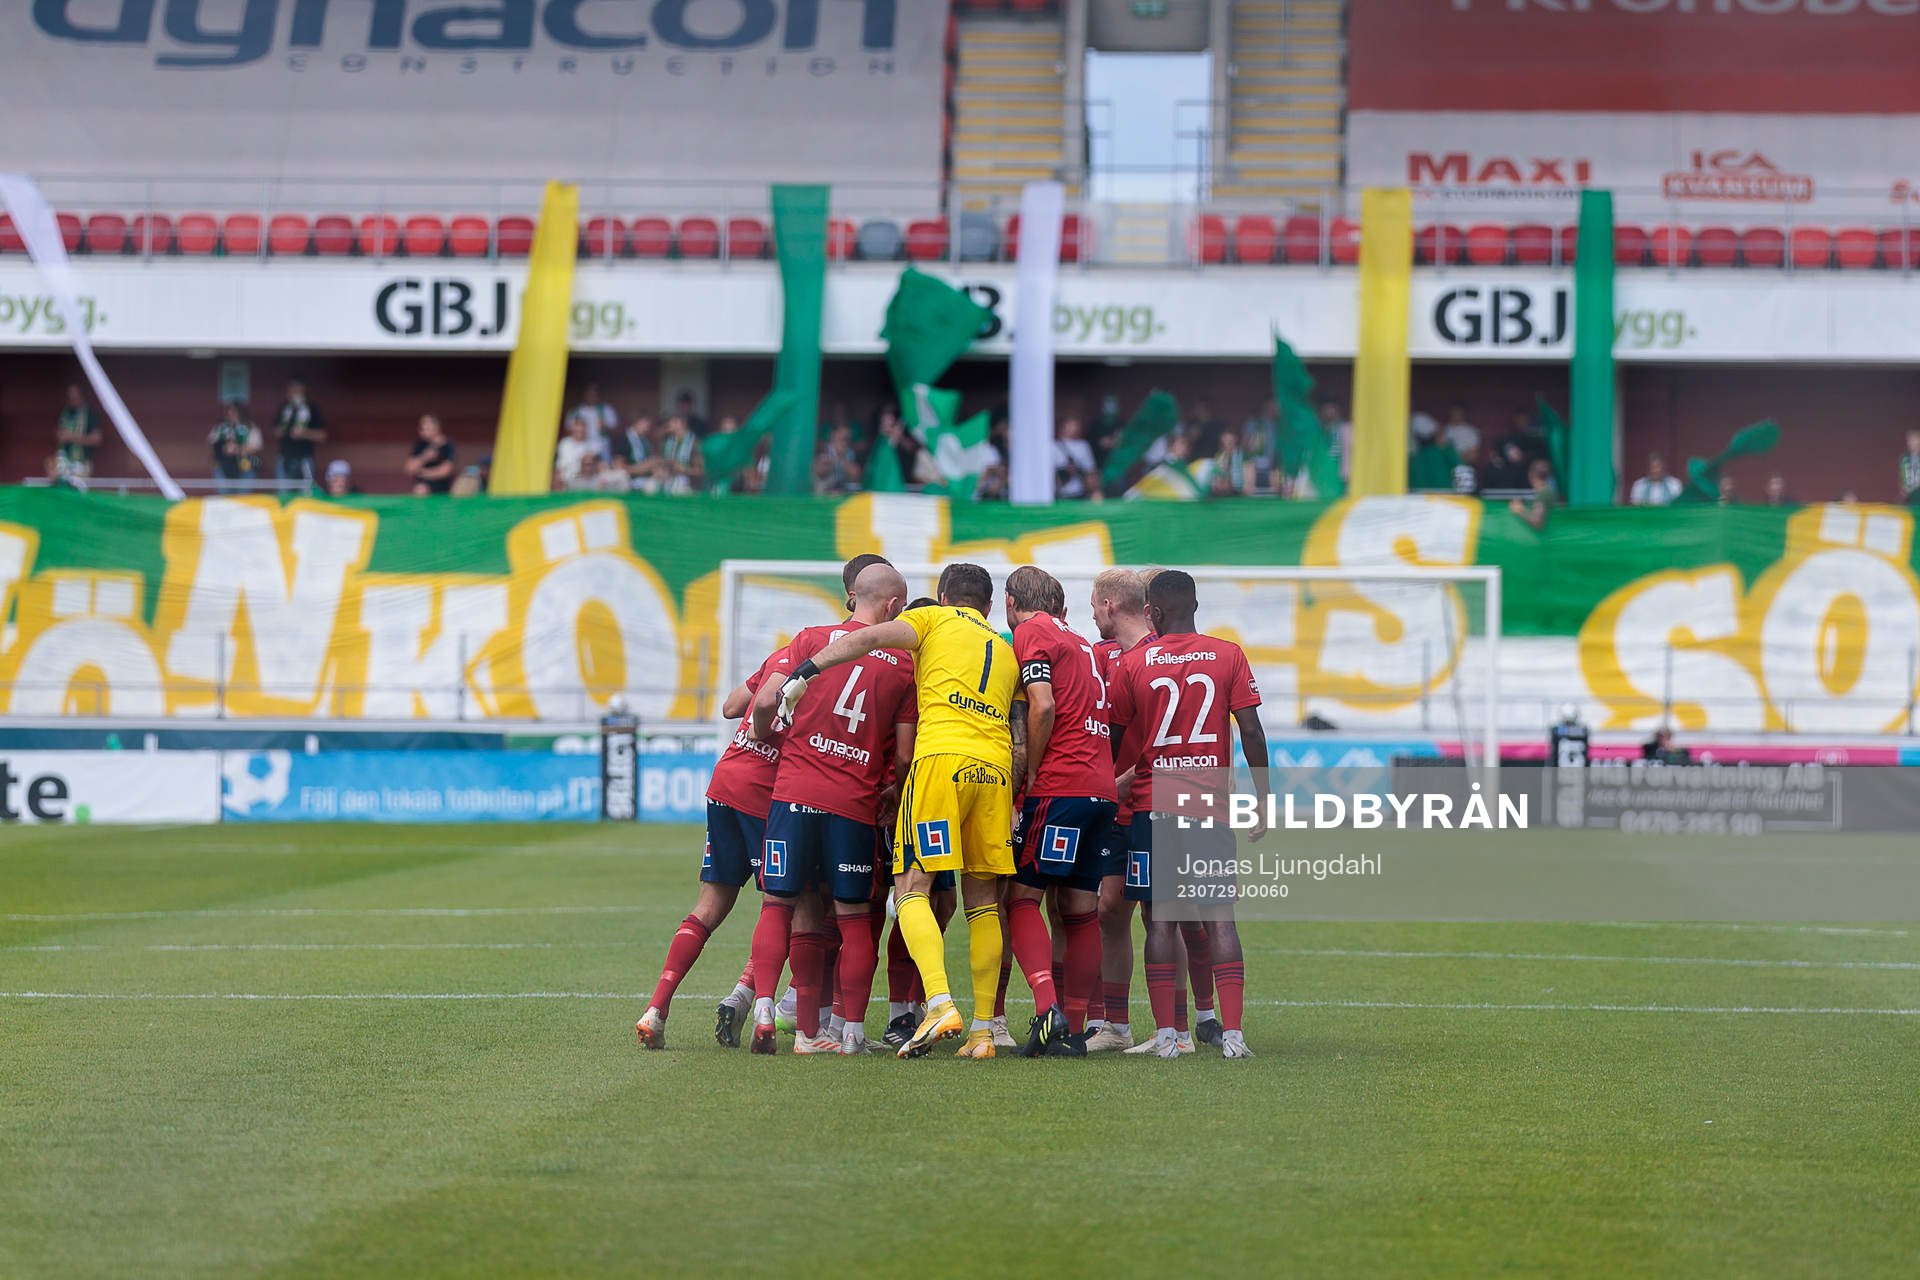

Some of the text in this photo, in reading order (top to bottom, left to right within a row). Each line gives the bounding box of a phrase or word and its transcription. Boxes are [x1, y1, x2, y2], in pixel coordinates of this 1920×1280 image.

[1407, 152, 1592, 185] MAXI
[1690, 150, 1780, 173] ICA
[374, 280, 508, 337] GBJ
[1433, 289, 1569, 346] GBJ
[978, 639, 993, 694] 1
[1146, 647, 1217, 667] Fellessons
[833, 665, 866, 734] 4
[1149, 673, 1218, 747] 22
[809, 732, 871, 763] dynacon
[1153, 754, 1218, 771] dynacon
